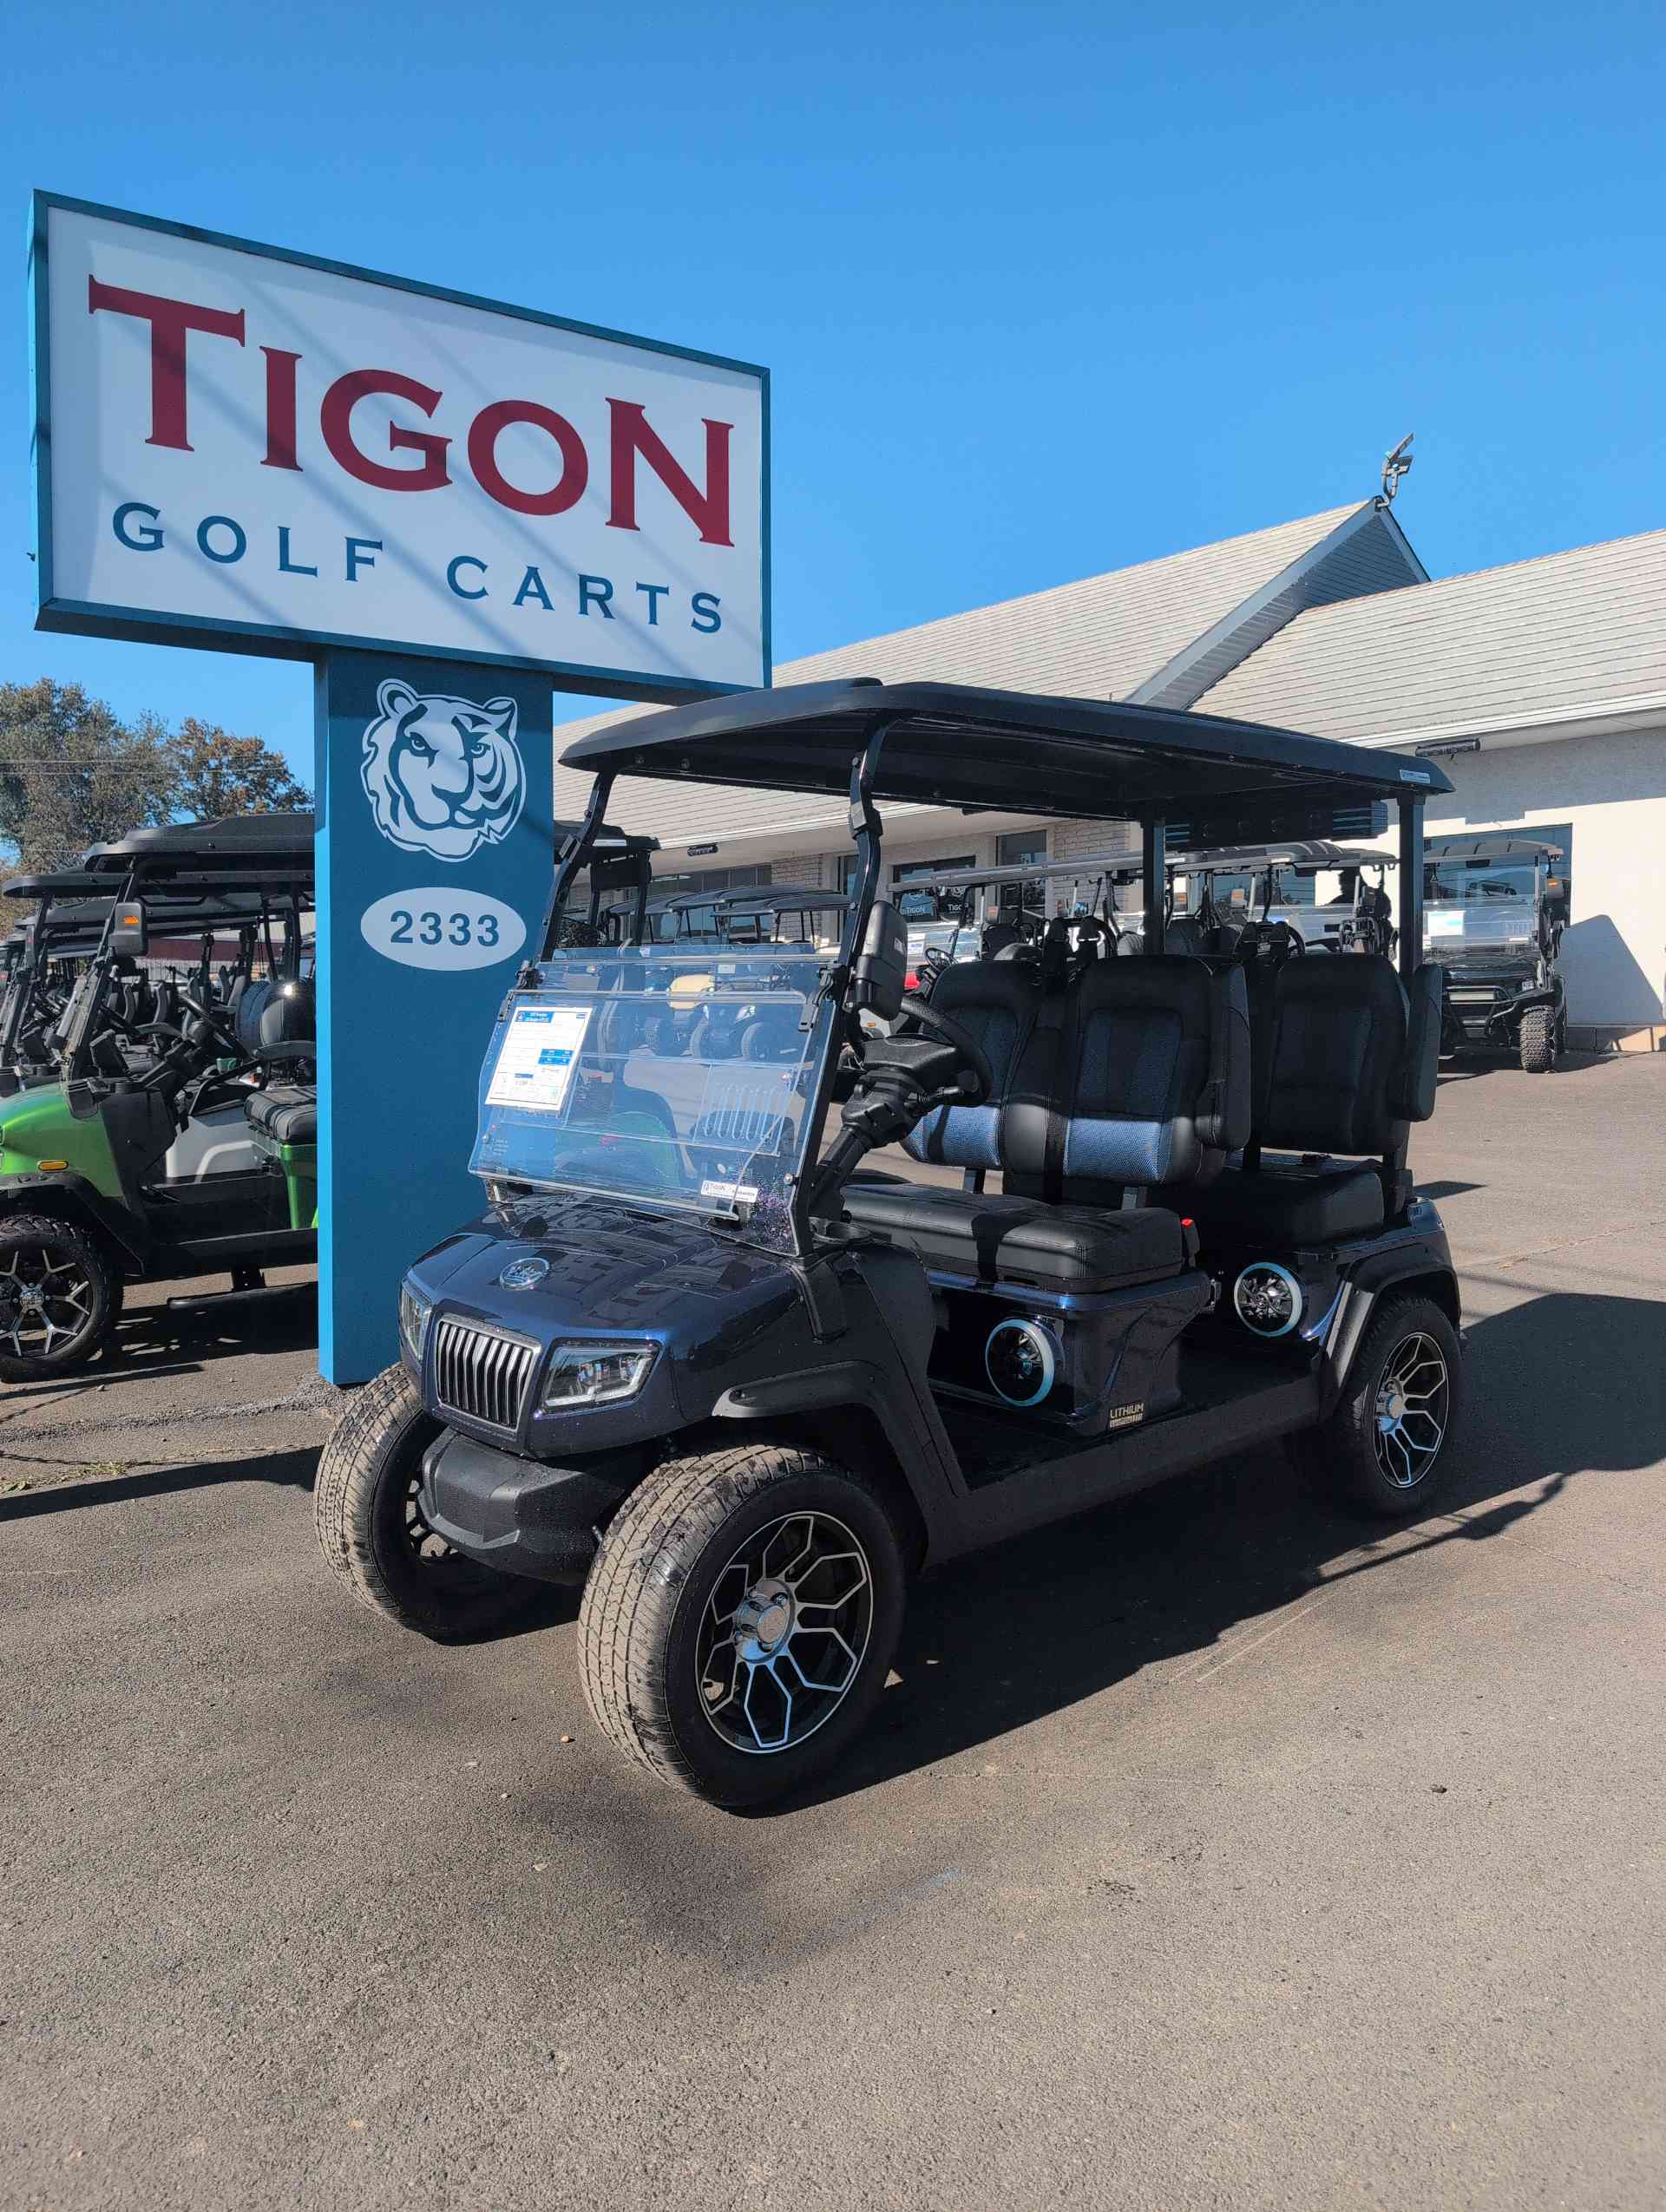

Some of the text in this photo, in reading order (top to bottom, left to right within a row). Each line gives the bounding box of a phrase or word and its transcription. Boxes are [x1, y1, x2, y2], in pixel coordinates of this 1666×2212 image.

[89, 274, 735, 547] TIGON
[113, 502, 723, 635] GOLF CARTS
[390, 910, 500, 947] 2333
[1110, 1403, 1144, 1418] LITHIUM
